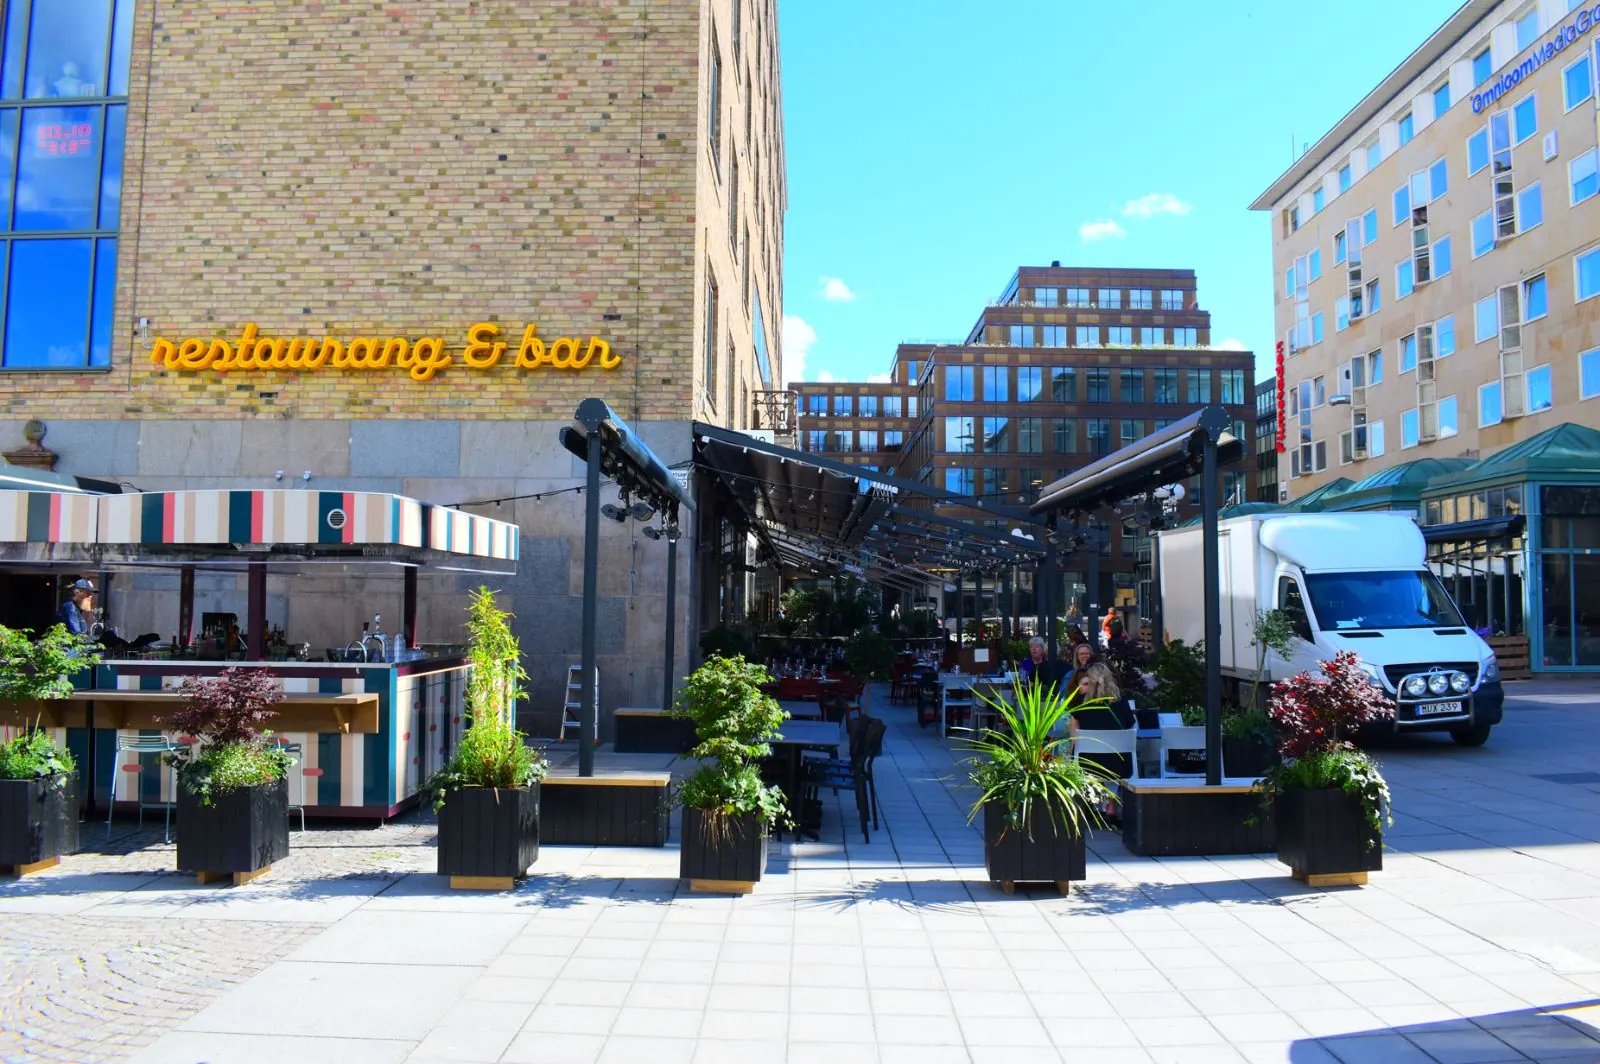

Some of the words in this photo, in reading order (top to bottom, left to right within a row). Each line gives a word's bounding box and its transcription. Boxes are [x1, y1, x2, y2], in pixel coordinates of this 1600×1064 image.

[150, 322, 453, 382] restaurang
[462, 322, 506, 369] &
[513, 322, 621, 370] bar
[1421, 703, 1438, 713] MUX
[1440, 702, 1458, 712] 239
